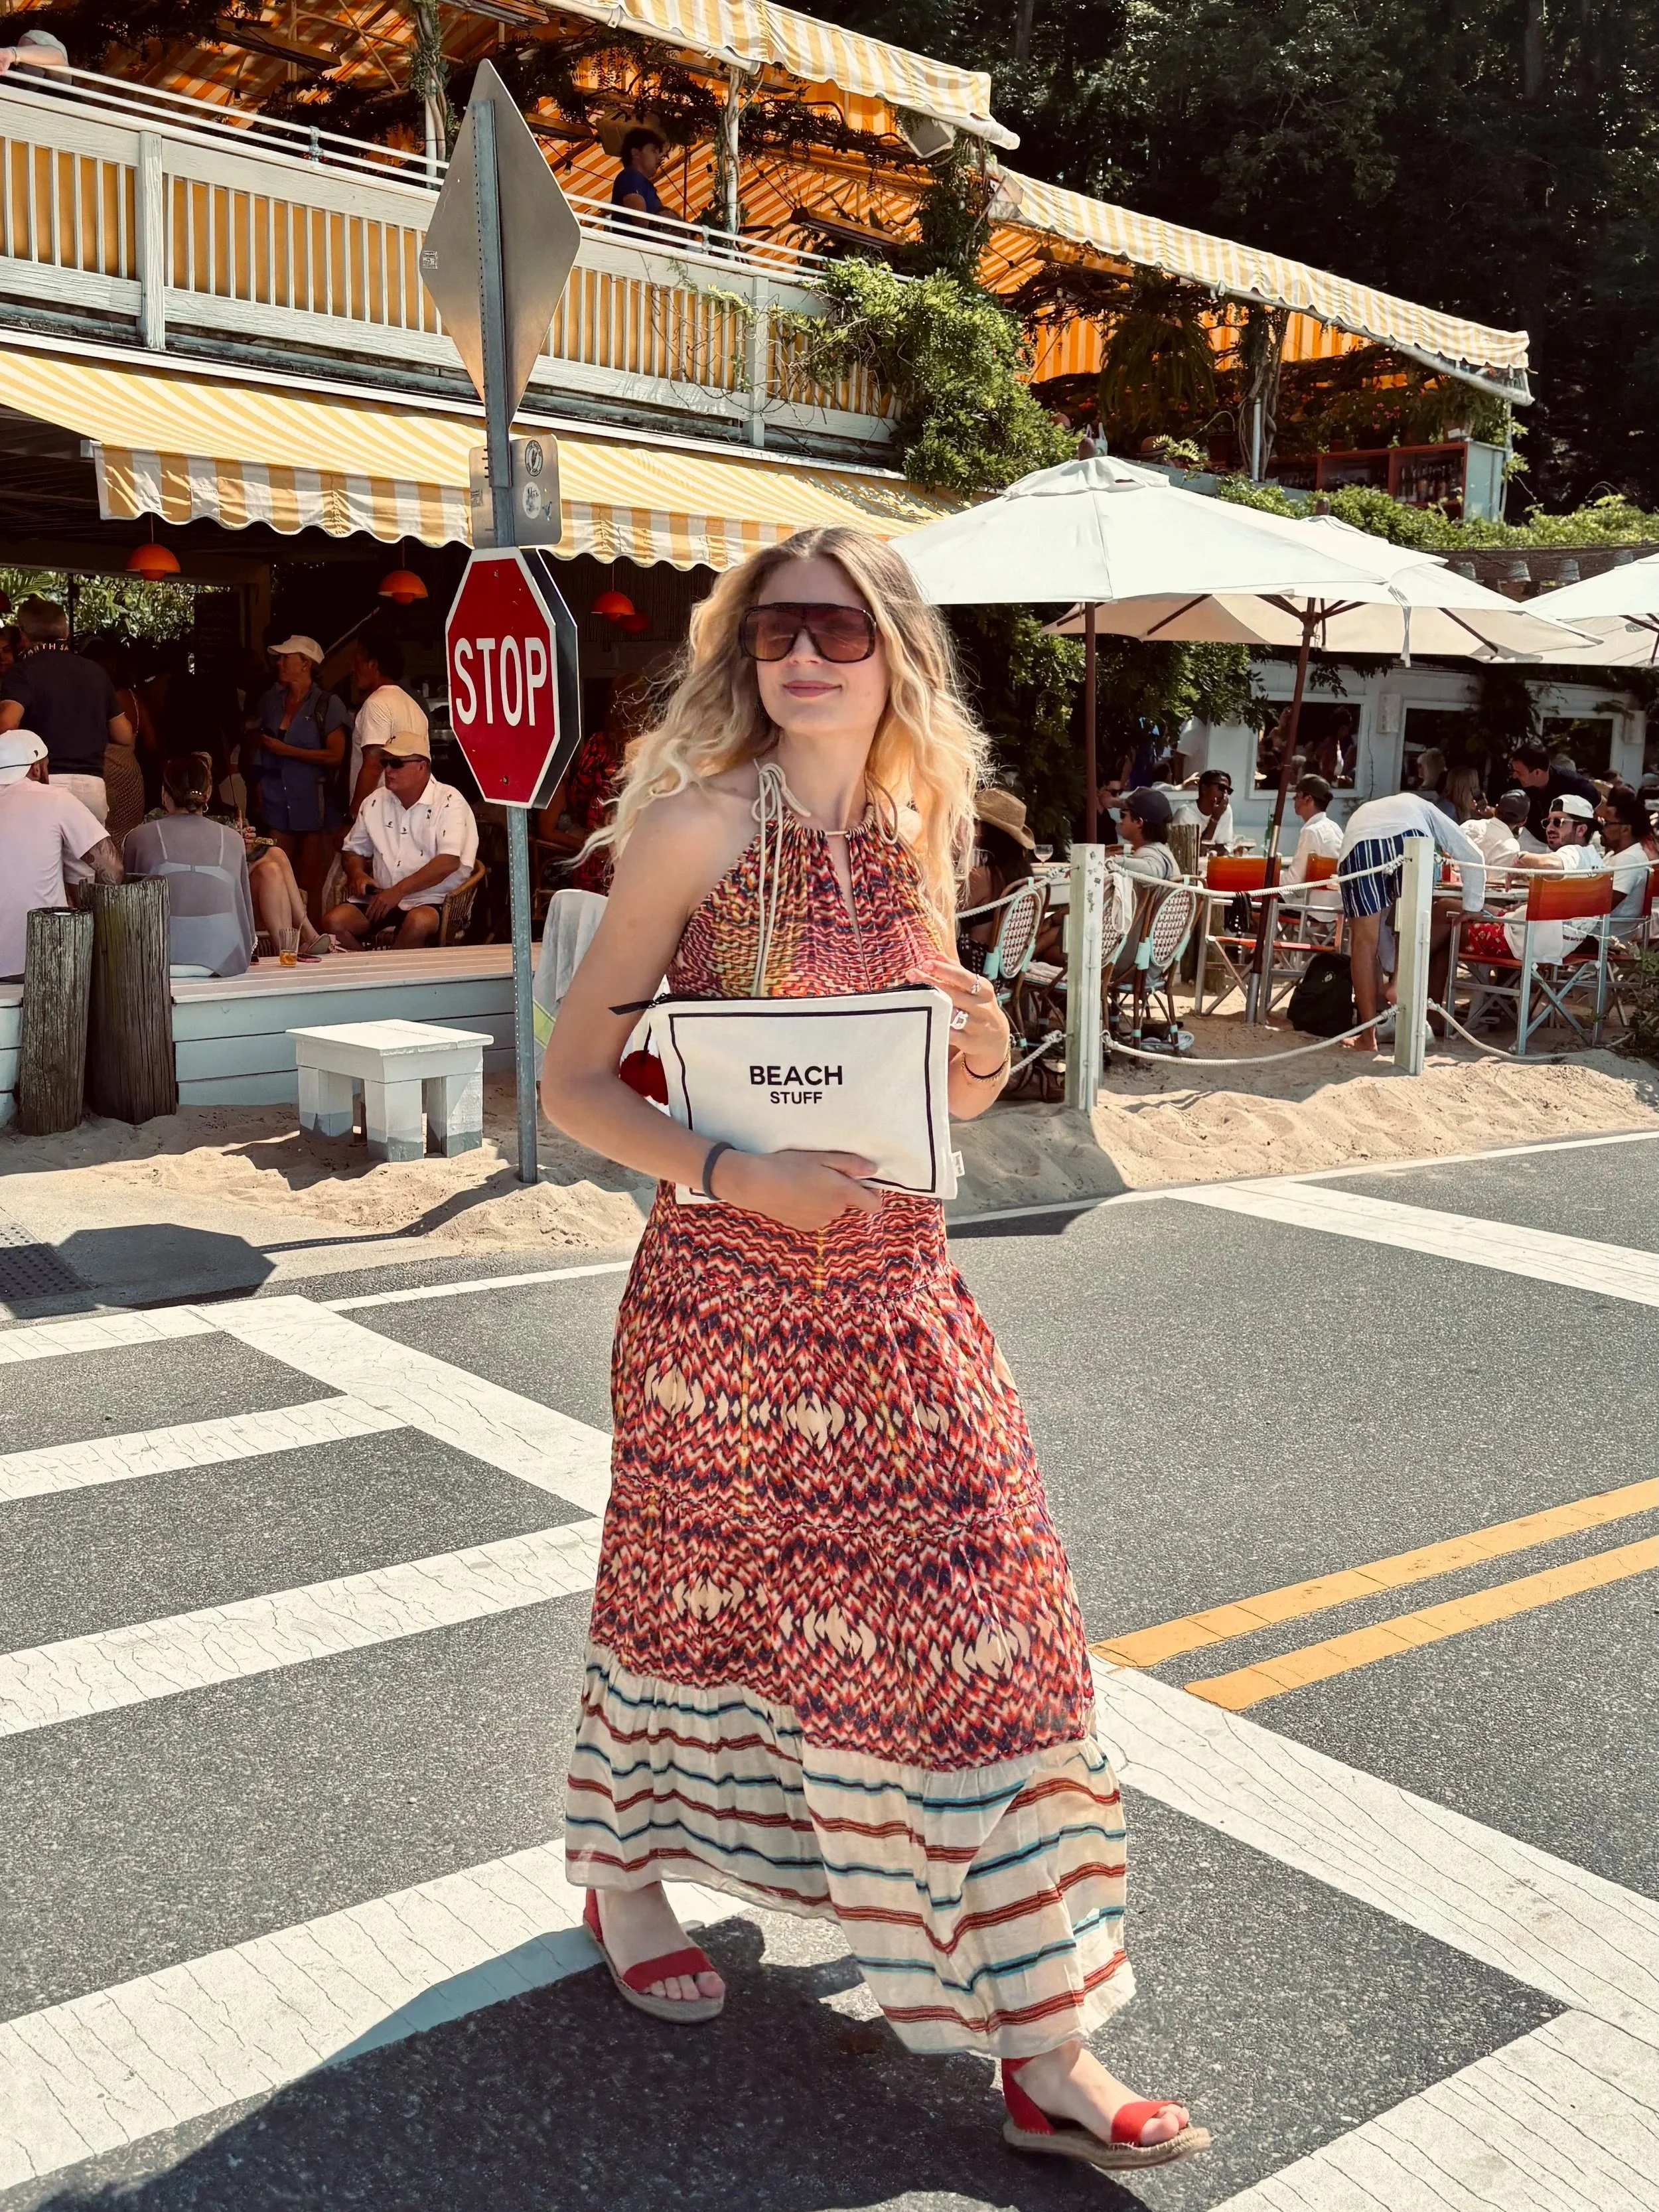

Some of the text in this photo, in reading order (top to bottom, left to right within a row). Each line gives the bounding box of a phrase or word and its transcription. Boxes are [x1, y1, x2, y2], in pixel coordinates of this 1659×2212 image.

[455, 635, 547, 726] STOP
[749, 1065, 843, 1086] BEACH
[770, 1091, 822, 1104] STUFF
